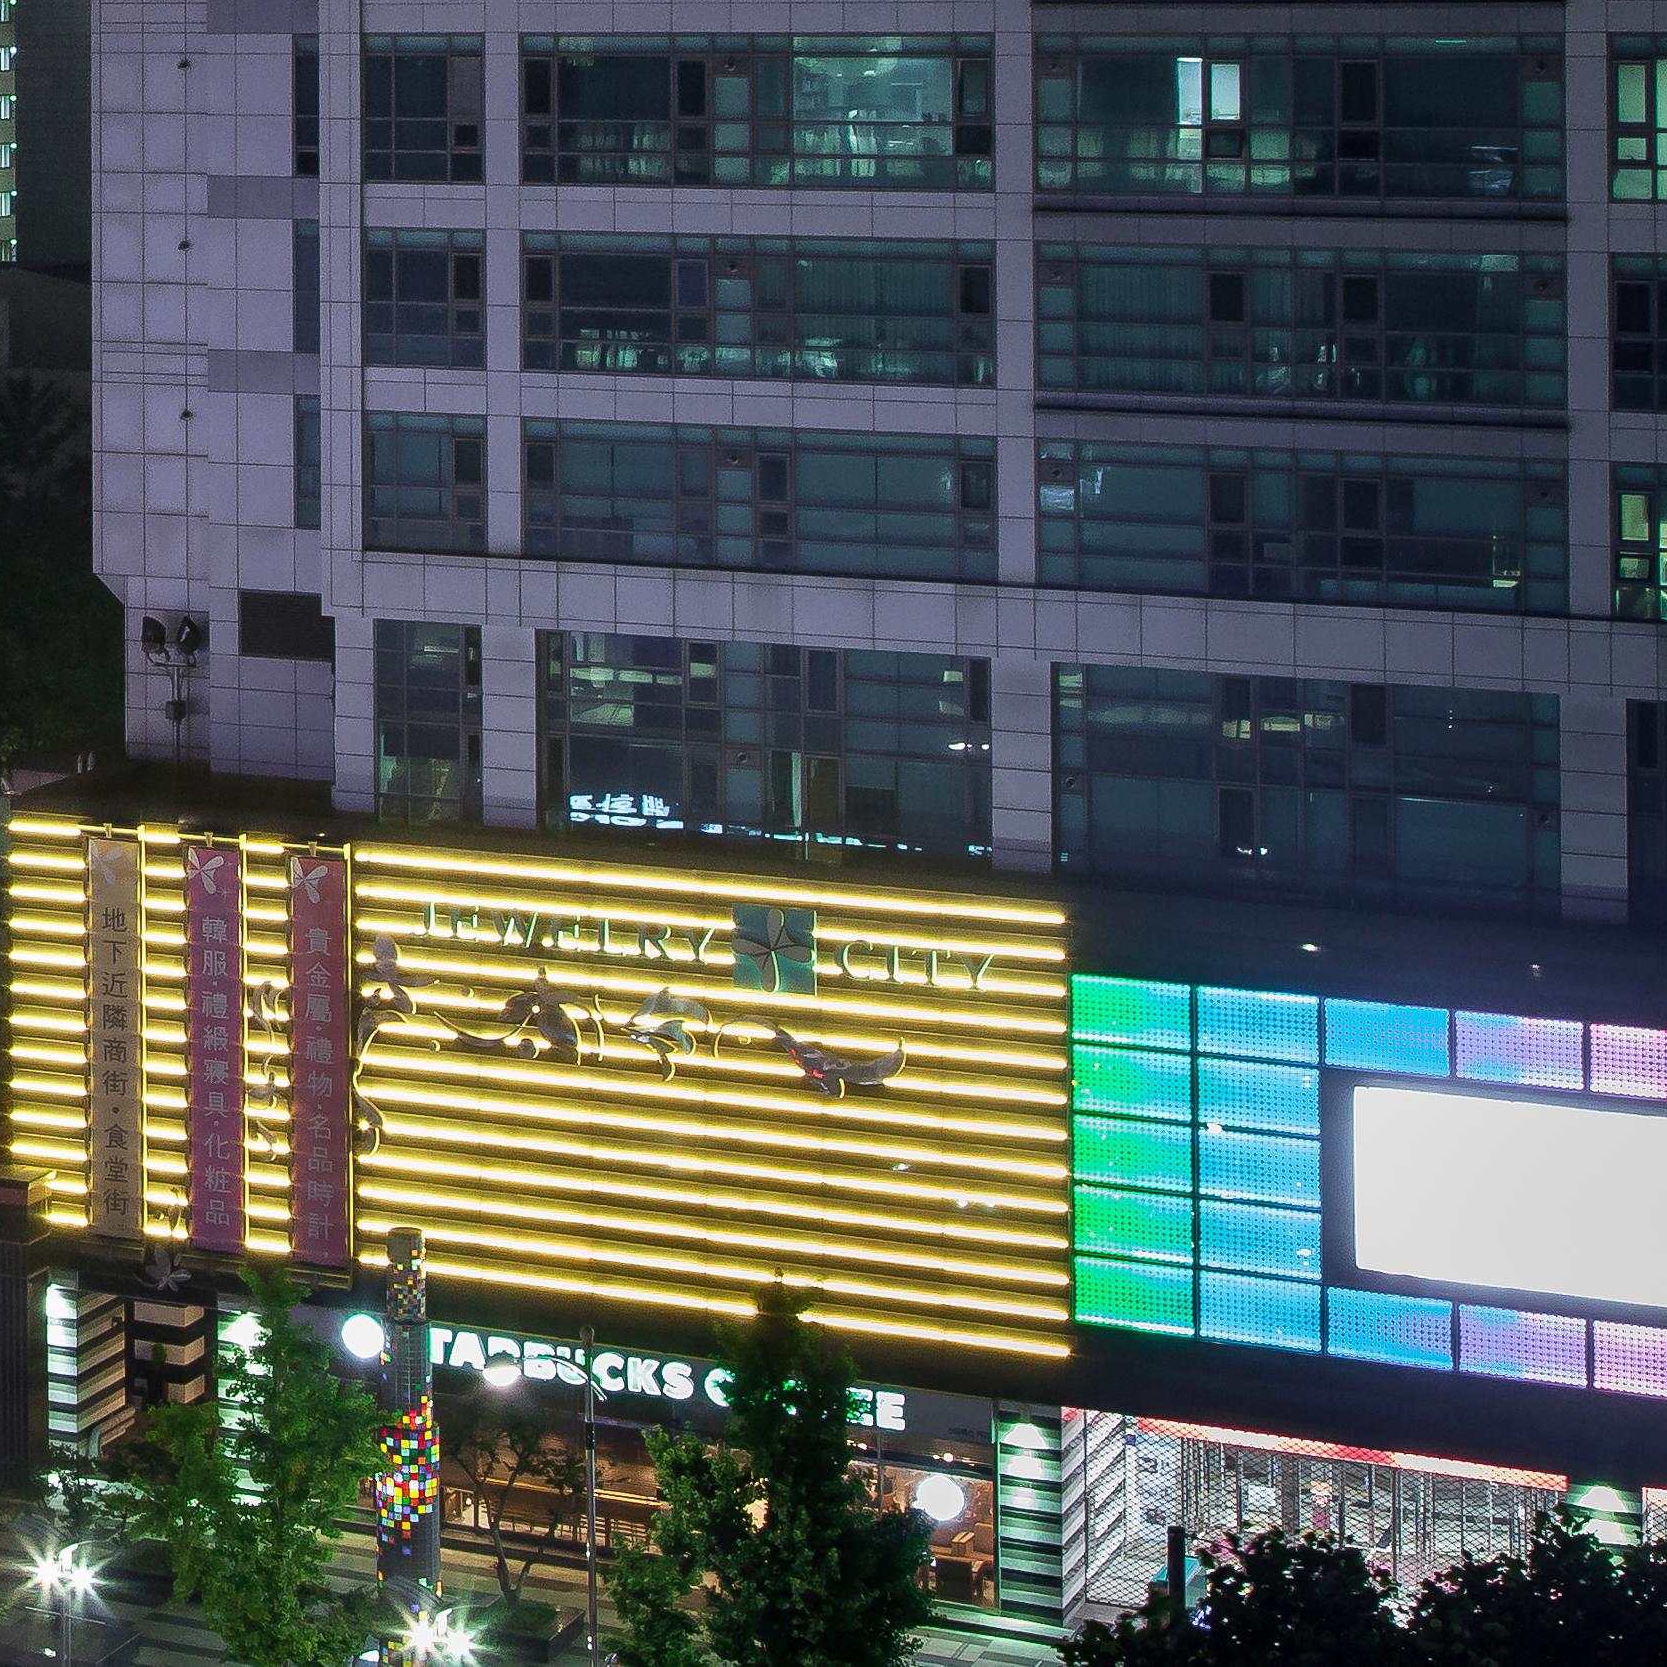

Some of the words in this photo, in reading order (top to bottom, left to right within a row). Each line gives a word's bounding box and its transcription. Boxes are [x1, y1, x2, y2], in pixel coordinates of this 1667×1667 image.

[413, 901, 716, 964] JEWELRY
[836, 939, 995, 991] CITY
[430, 1327, 693, 1401] TARBUCKS
